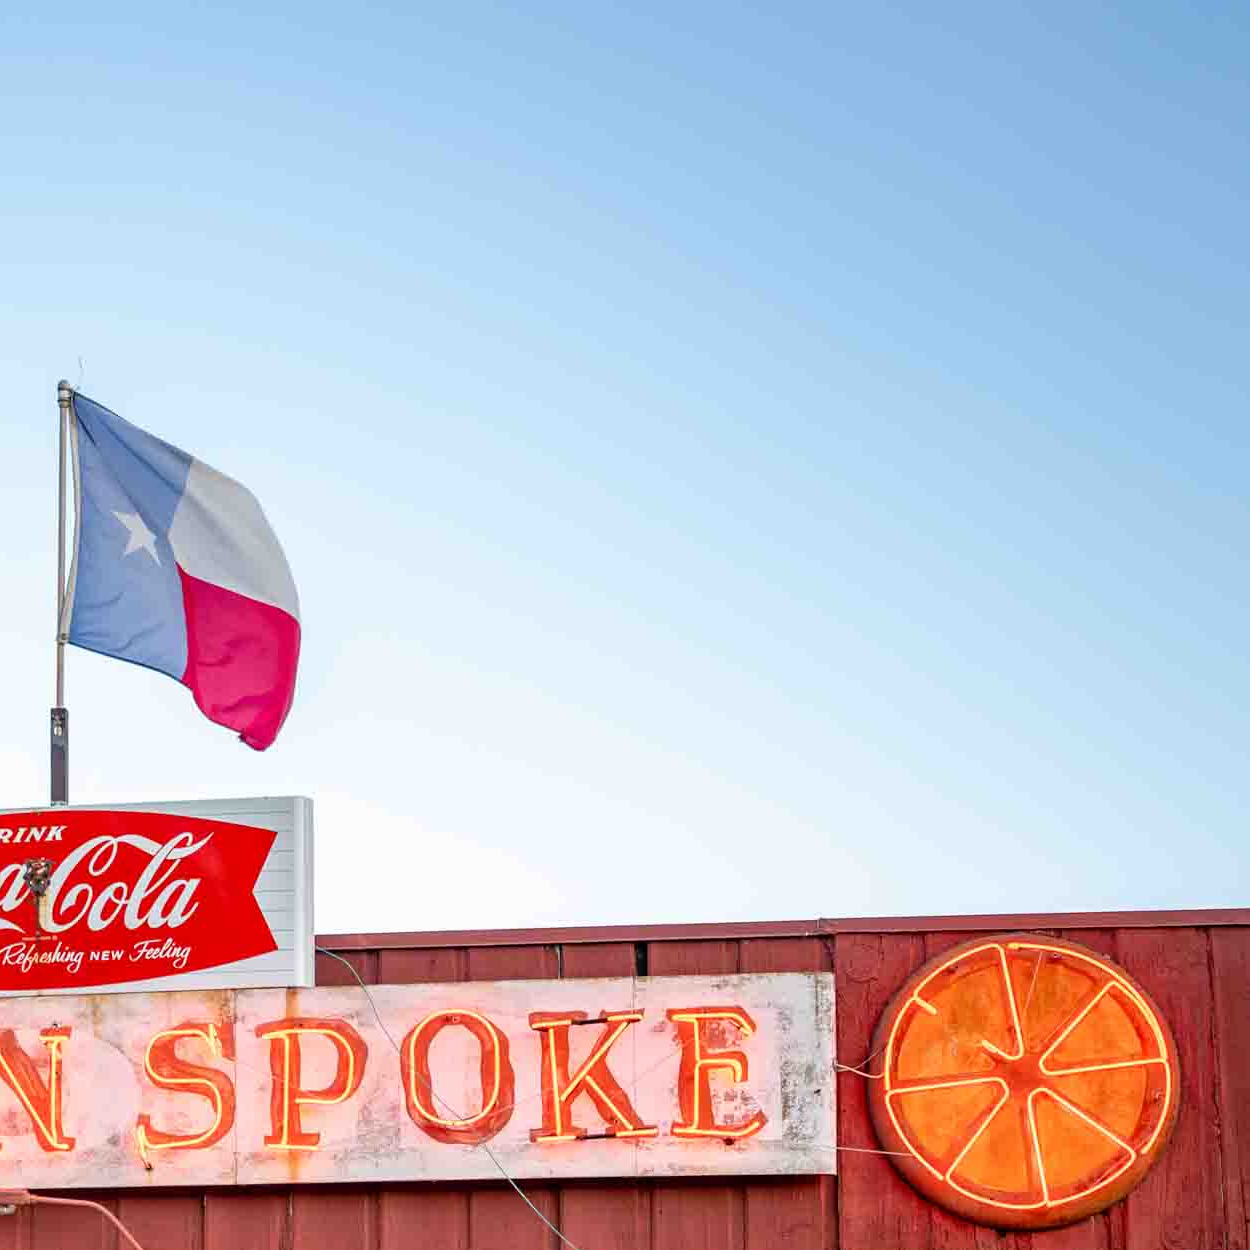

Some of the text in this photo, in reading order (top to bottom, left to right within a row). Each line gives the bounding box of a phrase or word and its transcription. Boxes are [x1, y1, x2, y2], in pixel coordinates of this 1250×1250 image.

[89, 950, 124, 961] NEW
[129, 938, 190, 969] Feeling
[136, 1006, 768, 1156] SPOKE
